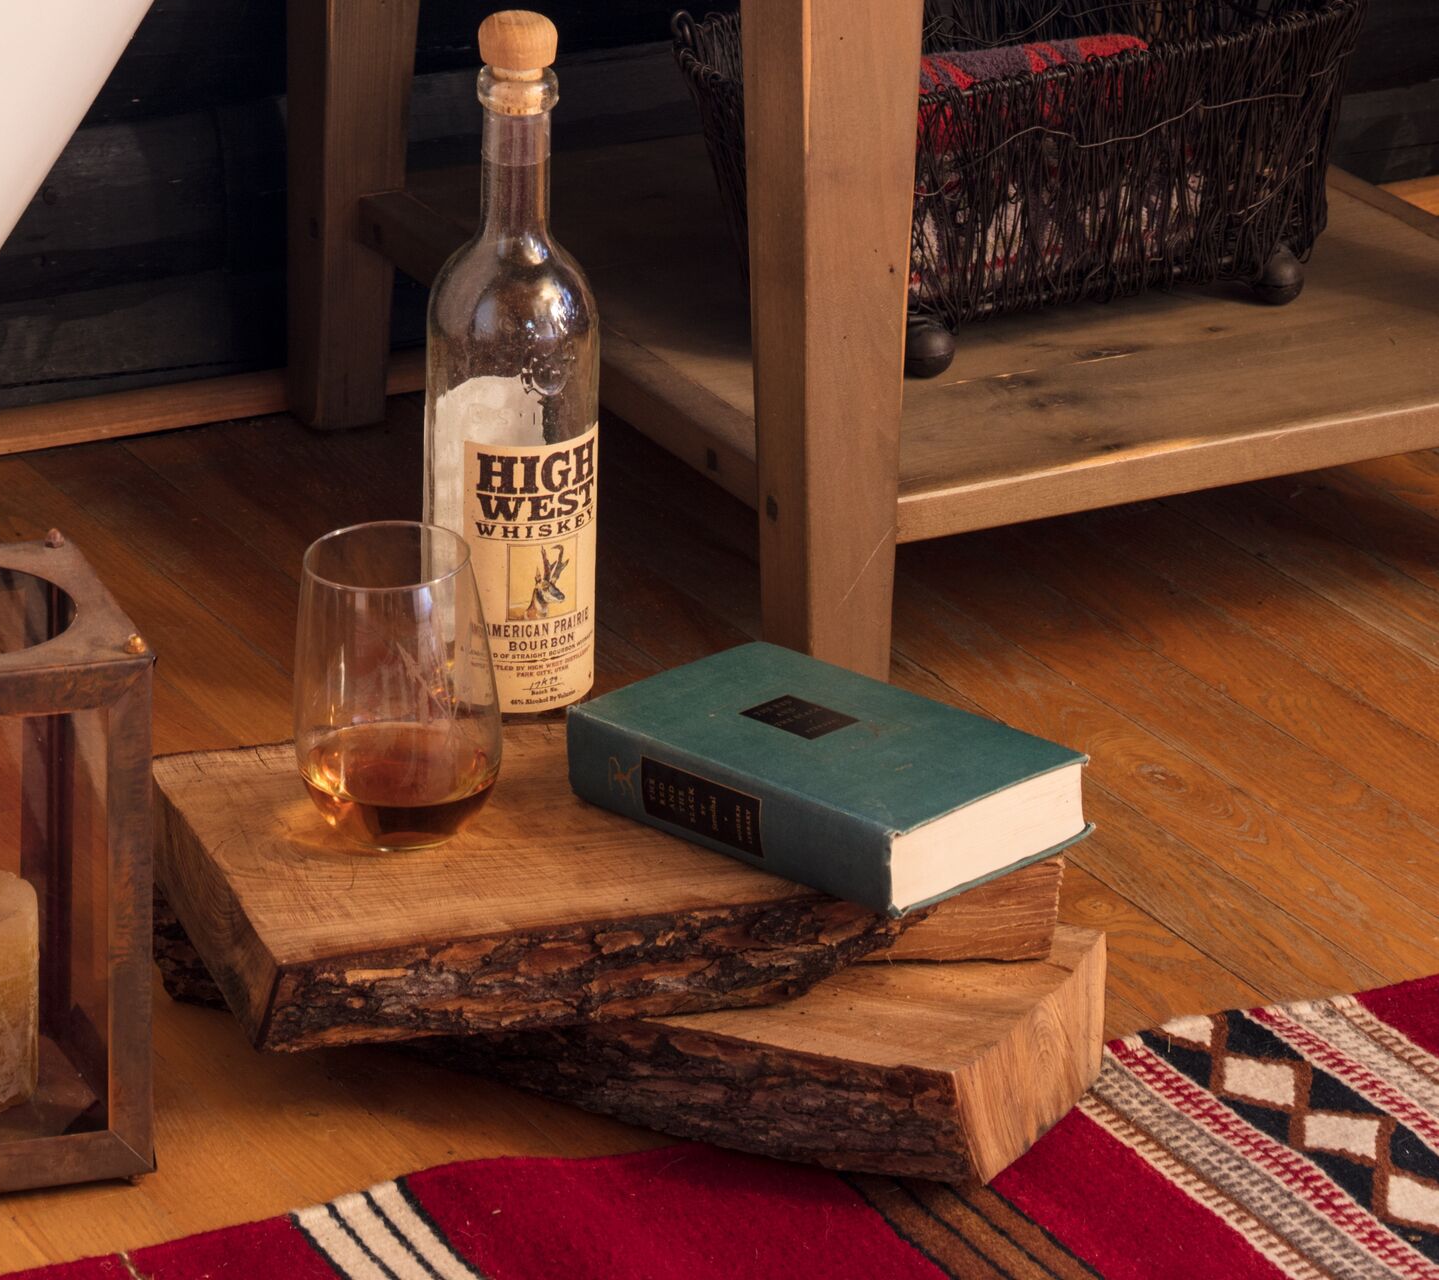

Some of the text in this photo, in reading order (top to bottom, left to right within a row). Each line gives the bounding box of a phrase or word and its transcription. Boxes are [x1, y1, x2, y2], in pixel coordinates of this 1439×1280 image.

[476, 436, 595, 494] HIGH
[476, 479, 594, 522] WEST
[475, 505, 593, 539] WHISKEY
[554, 607, 588, 633] PRAIRIE
[509, 632, 575, 652] BOURBON
[511, 651, 546, 660] STRAIGHT
